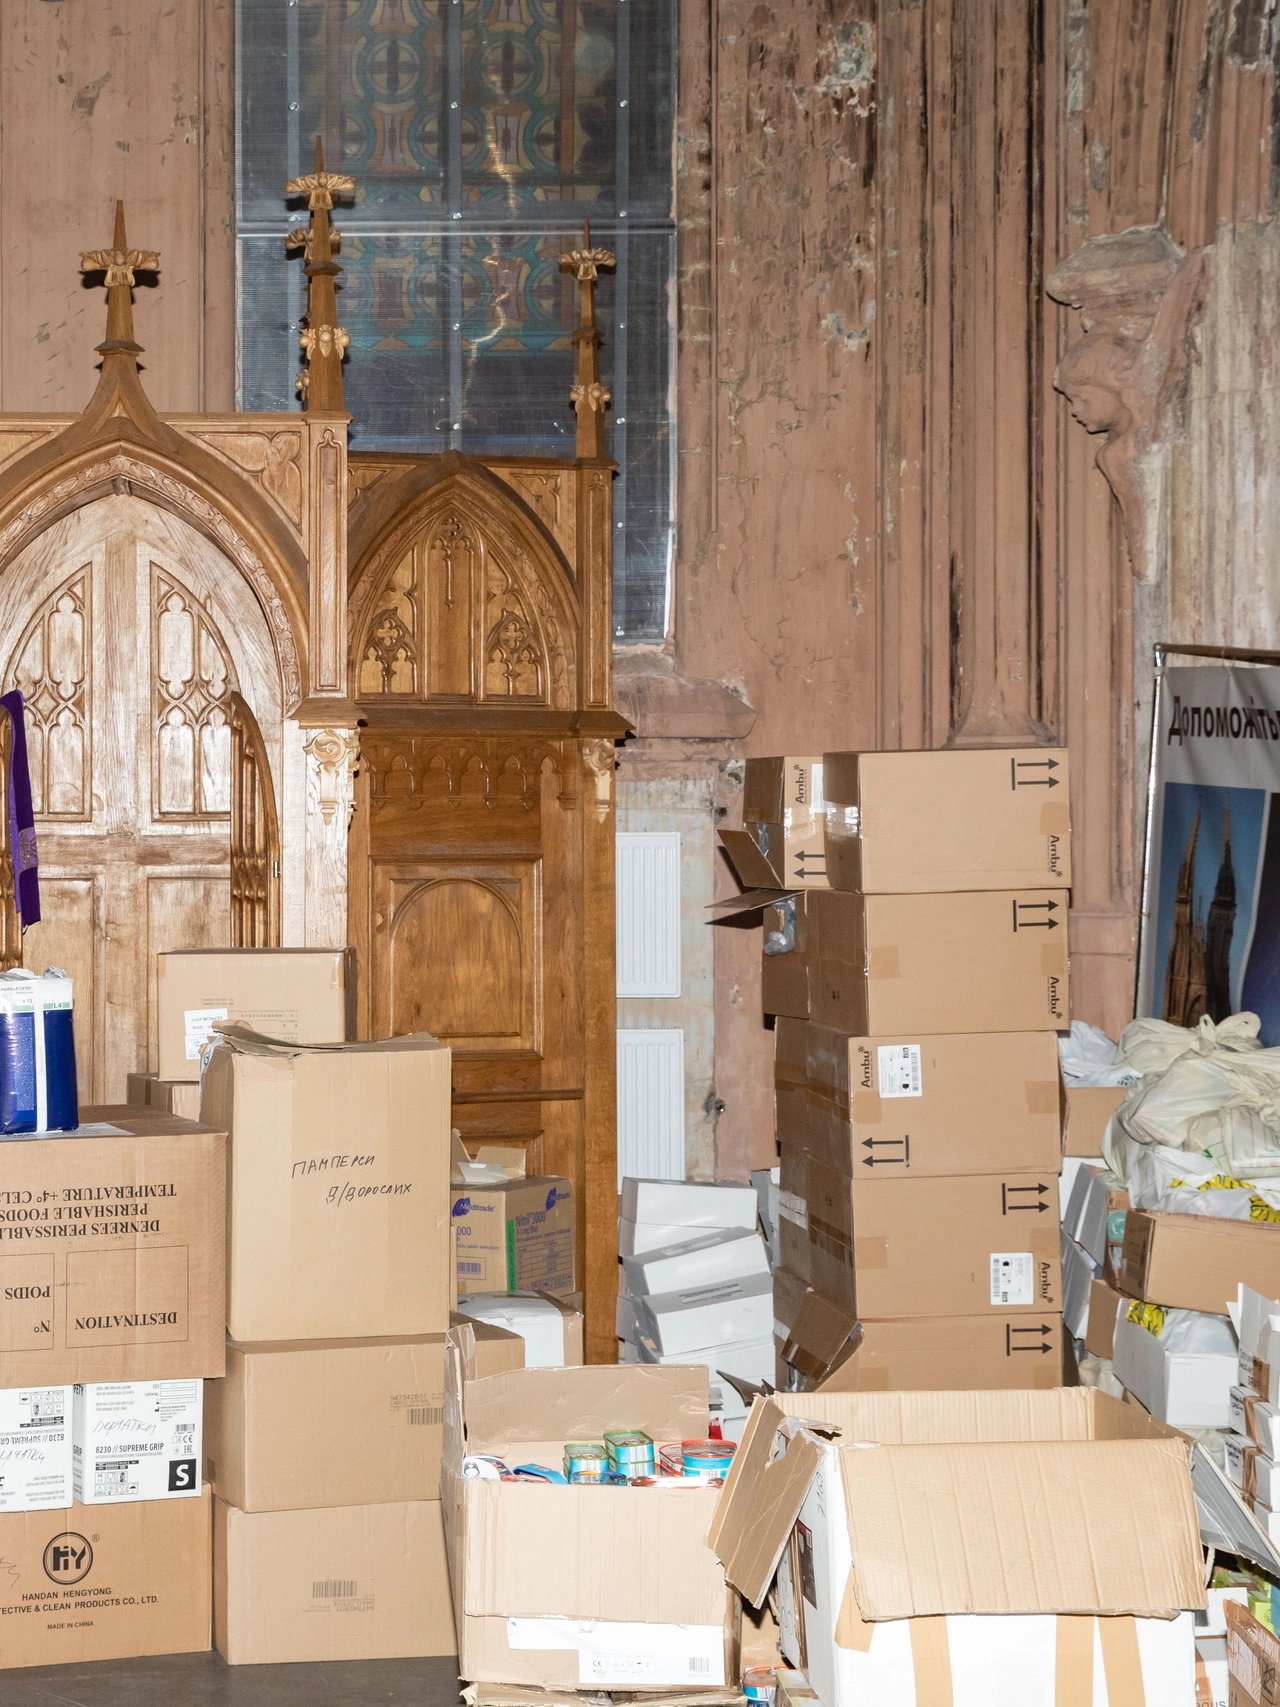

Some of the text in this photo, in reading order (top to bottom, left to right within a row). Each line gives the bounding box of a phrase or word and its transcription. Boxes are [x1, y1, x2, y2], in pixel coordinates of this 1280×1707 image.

[795, 768, 804, 804] Ambu
[1050, 834, 1060, 873] Ambu
[1050, 976, 1060, 1014] Ambu
[861, 1051, 870, 1088] Ambu
[63, 1183, 177, 1202] TEMPERATURE
[53, 1203, 148, 1220] PERISHABLE
[91, 1219, 160, 1236] DENREES
[1041, 1262, 1051, 1299] Ambu
[5, 1285, 51, 1300] POIDS
[33, 1320, 51, 1333] N°
[75, 1311, 178, 1330] DESTINATION
[13, 1436, 41, 1444] SUPREME
[48, 1433, 64, 1442] 8230
[119, 1444, 148, 1452] SUPREME
[149, 1442, 164, 1451] GRIP
[175, 1464, 190, 1486] S
[22, 1587, 112, 1601] HANDAN HENGYONG
[42, 1602, 71, 1611] CLEAN
[74, 1598, 120, 1609] PRODUCTS
[122, 1596, 140, 1606] CO.,
[141, 1595, 160, 1604] LTD.
[47, 1622, 66, 1630] MADE
[74, 1620, 94, 1628] CHINA
